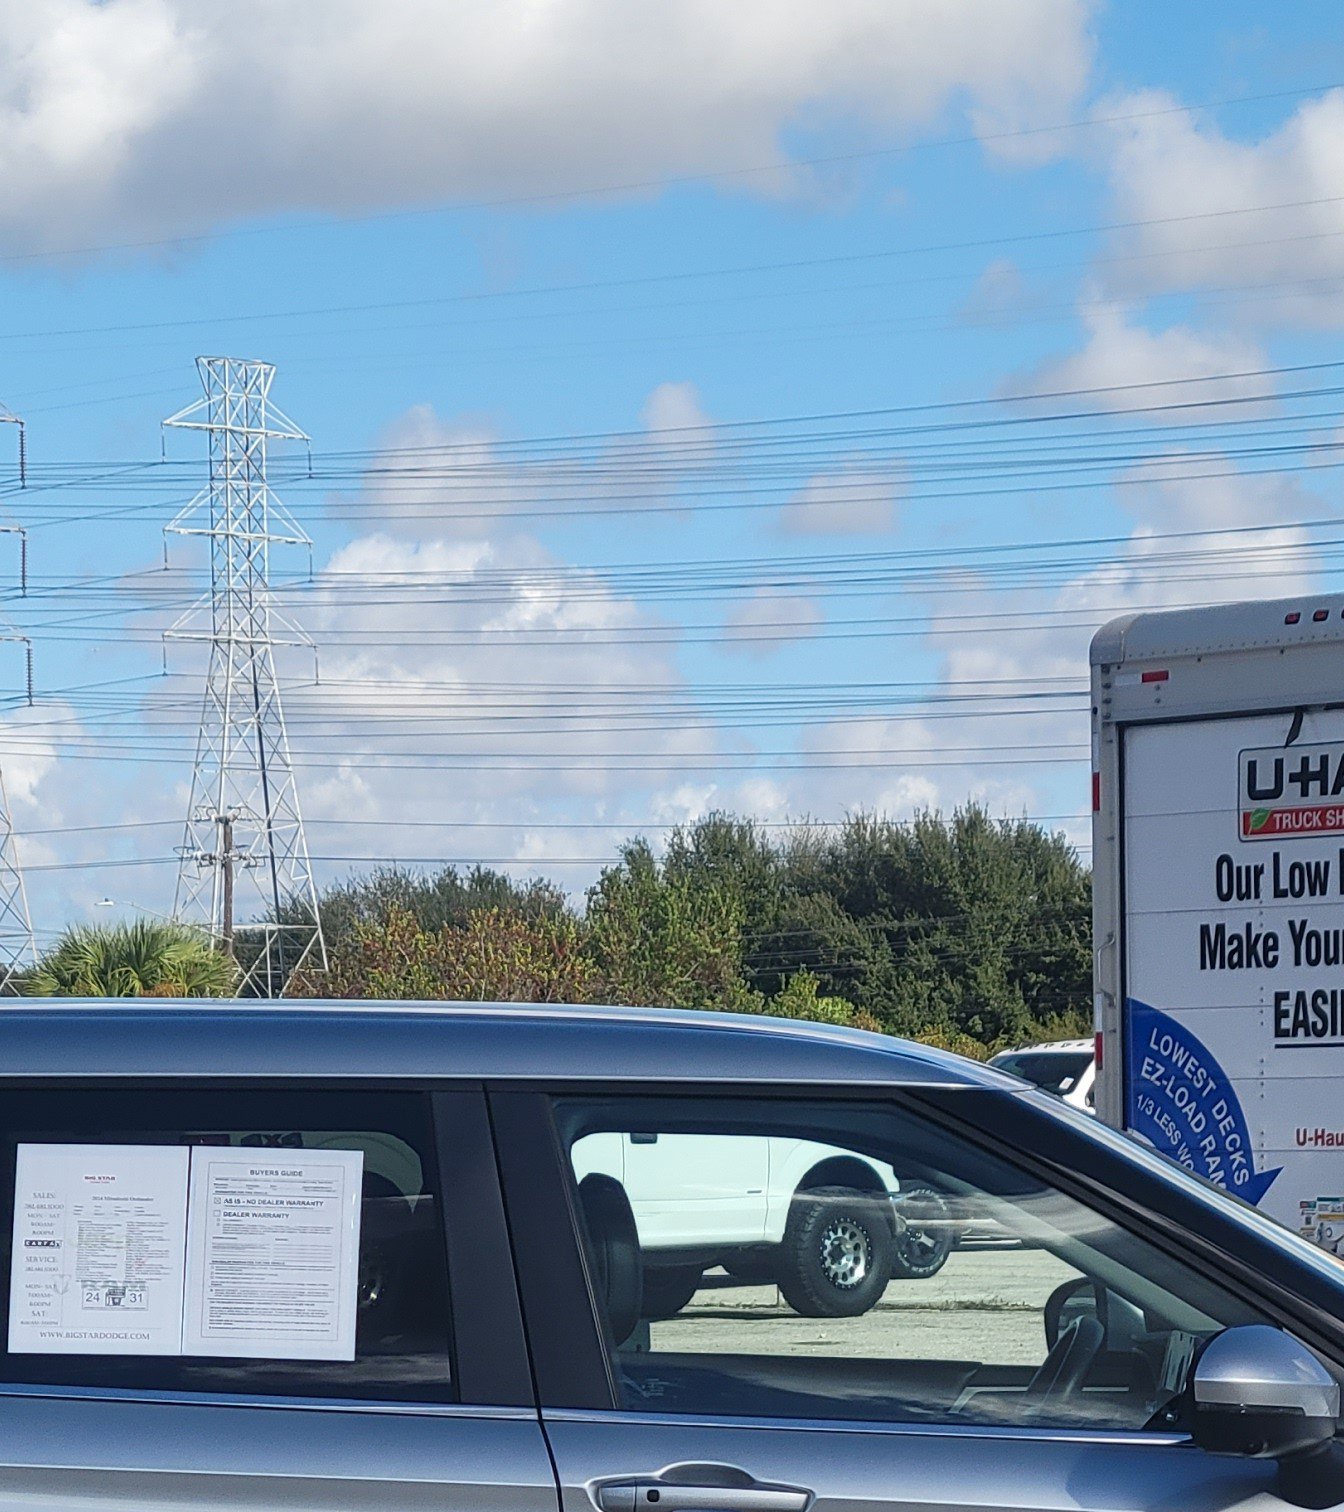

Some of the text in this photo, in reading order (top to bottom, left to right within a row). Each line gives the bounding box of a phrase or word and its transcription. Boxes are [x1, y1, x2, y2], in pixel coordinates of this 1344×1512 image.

[1273, 811, 1322, 830] TRUCK
[1216, 853, 1265, 902] Our
[1273, 851, 1330, 898] Low
[1199, 921, 1279, 970] Make
[1137, 1094, 1155, 1116] 1/3
[1153, 1106, 1182, 1146] LESS
[1140, 1056, 1206, 1134] EZ-LOAD
[1149, 1027, 1250, 1186] LOWEST DECKS
[85, 1292, 100, 1302] 24
[129, 1292, 143, 1303] 31
